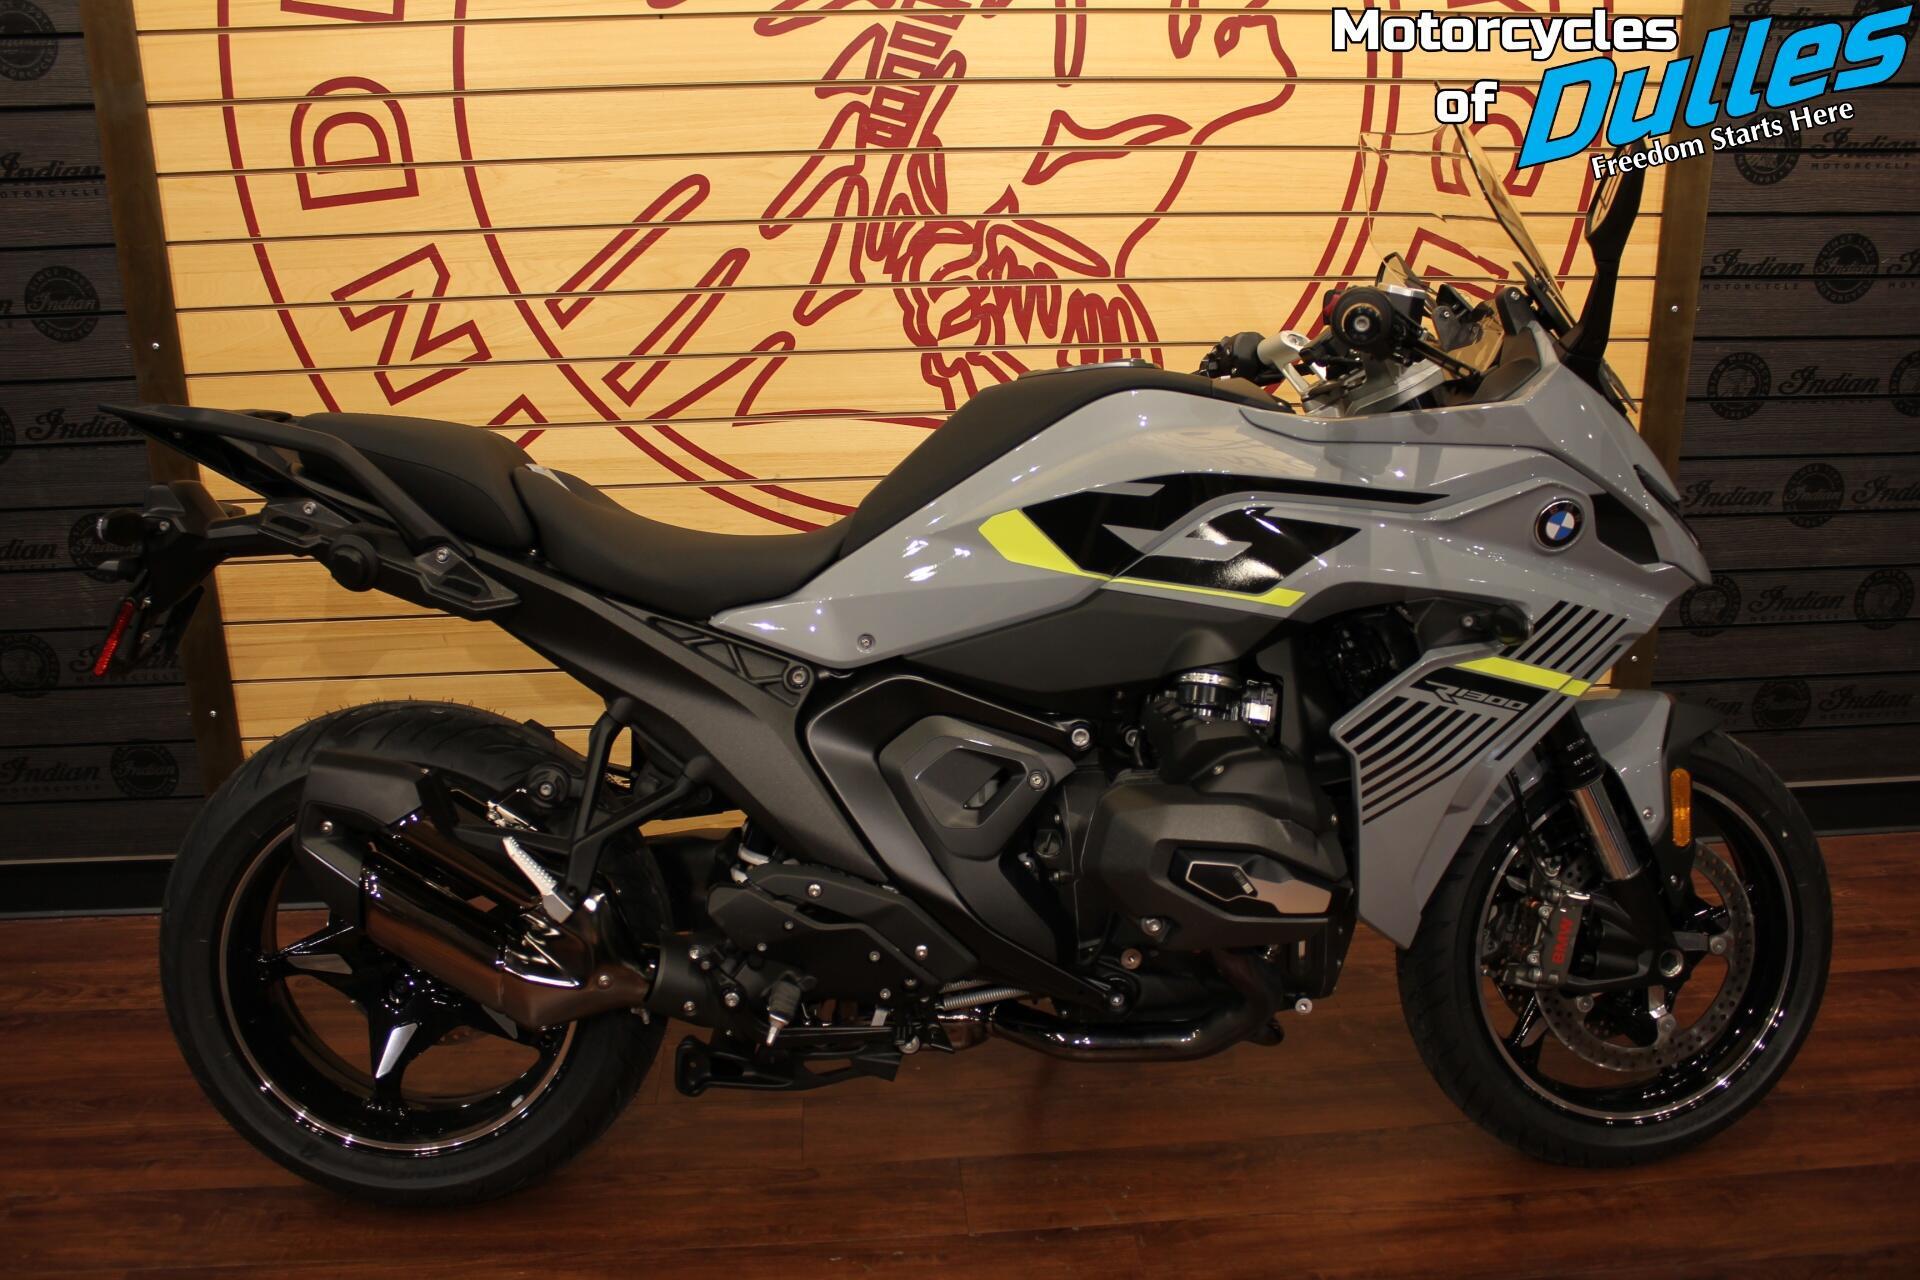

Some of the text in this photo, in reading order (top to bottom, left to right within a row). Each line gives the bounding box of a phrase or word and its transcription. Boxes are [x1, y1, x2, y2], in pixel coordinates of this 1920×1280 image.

[1810, 128, 1917, 159] Indian
[1811, 162, 1910, 170] MOTORCYCLE
[1701, 248, 1805, 277] Indian
[1702, 281, 1799, 291] MOTORCYCLE
[1778, 365, 1880, 394] Indian
[1682, 480, 1774, 507] Indian
[1747, 585, 1845, 613] Indian
[1819, 684, 1912, 713] Indian
[0, 756, 99, 786] Indian
